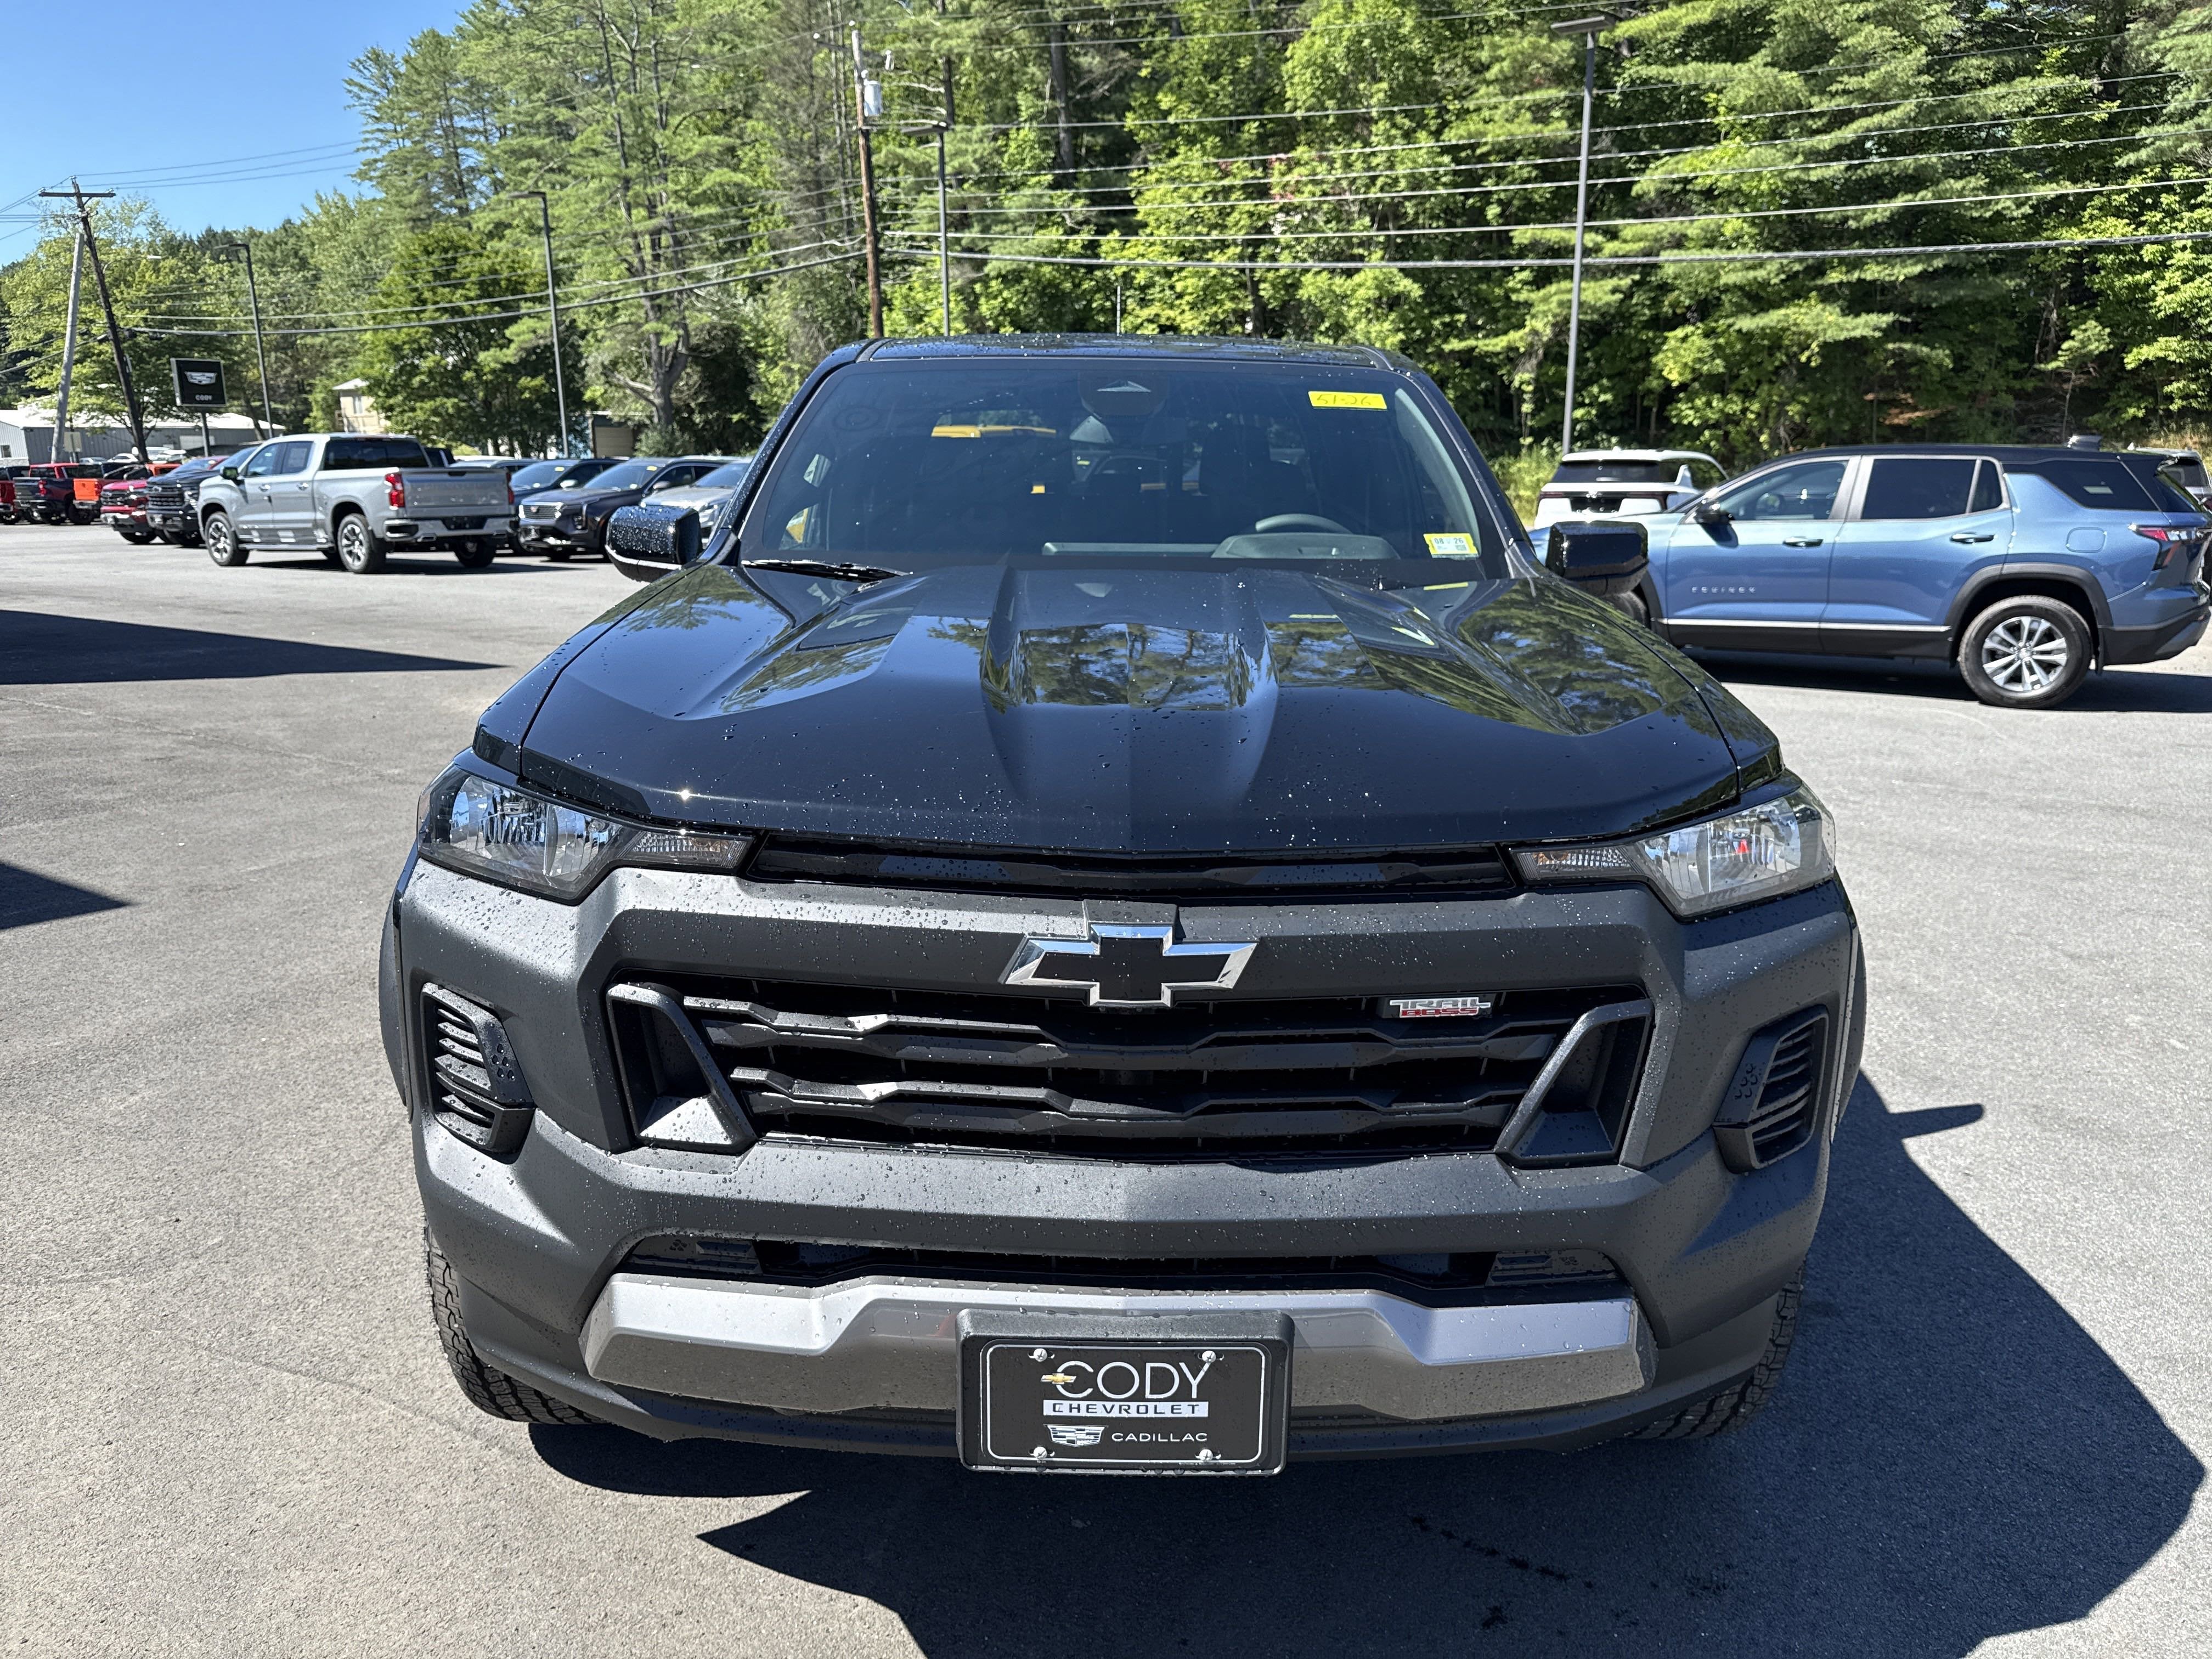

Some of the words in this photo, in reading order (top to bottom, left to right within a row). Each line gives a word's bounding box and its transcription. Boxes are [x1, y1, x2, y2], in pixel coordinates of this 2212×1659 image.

[1390, 997, 1491, 1009] TRAIL
[1400, 1007, 1479, 1017] BOSS
[1056, 1361, 1211, 1399] CODY
[1052, 1402, 1200, 1415] CHEVROLET
[1111, 1432, 1208, 1442] CADILLAC
